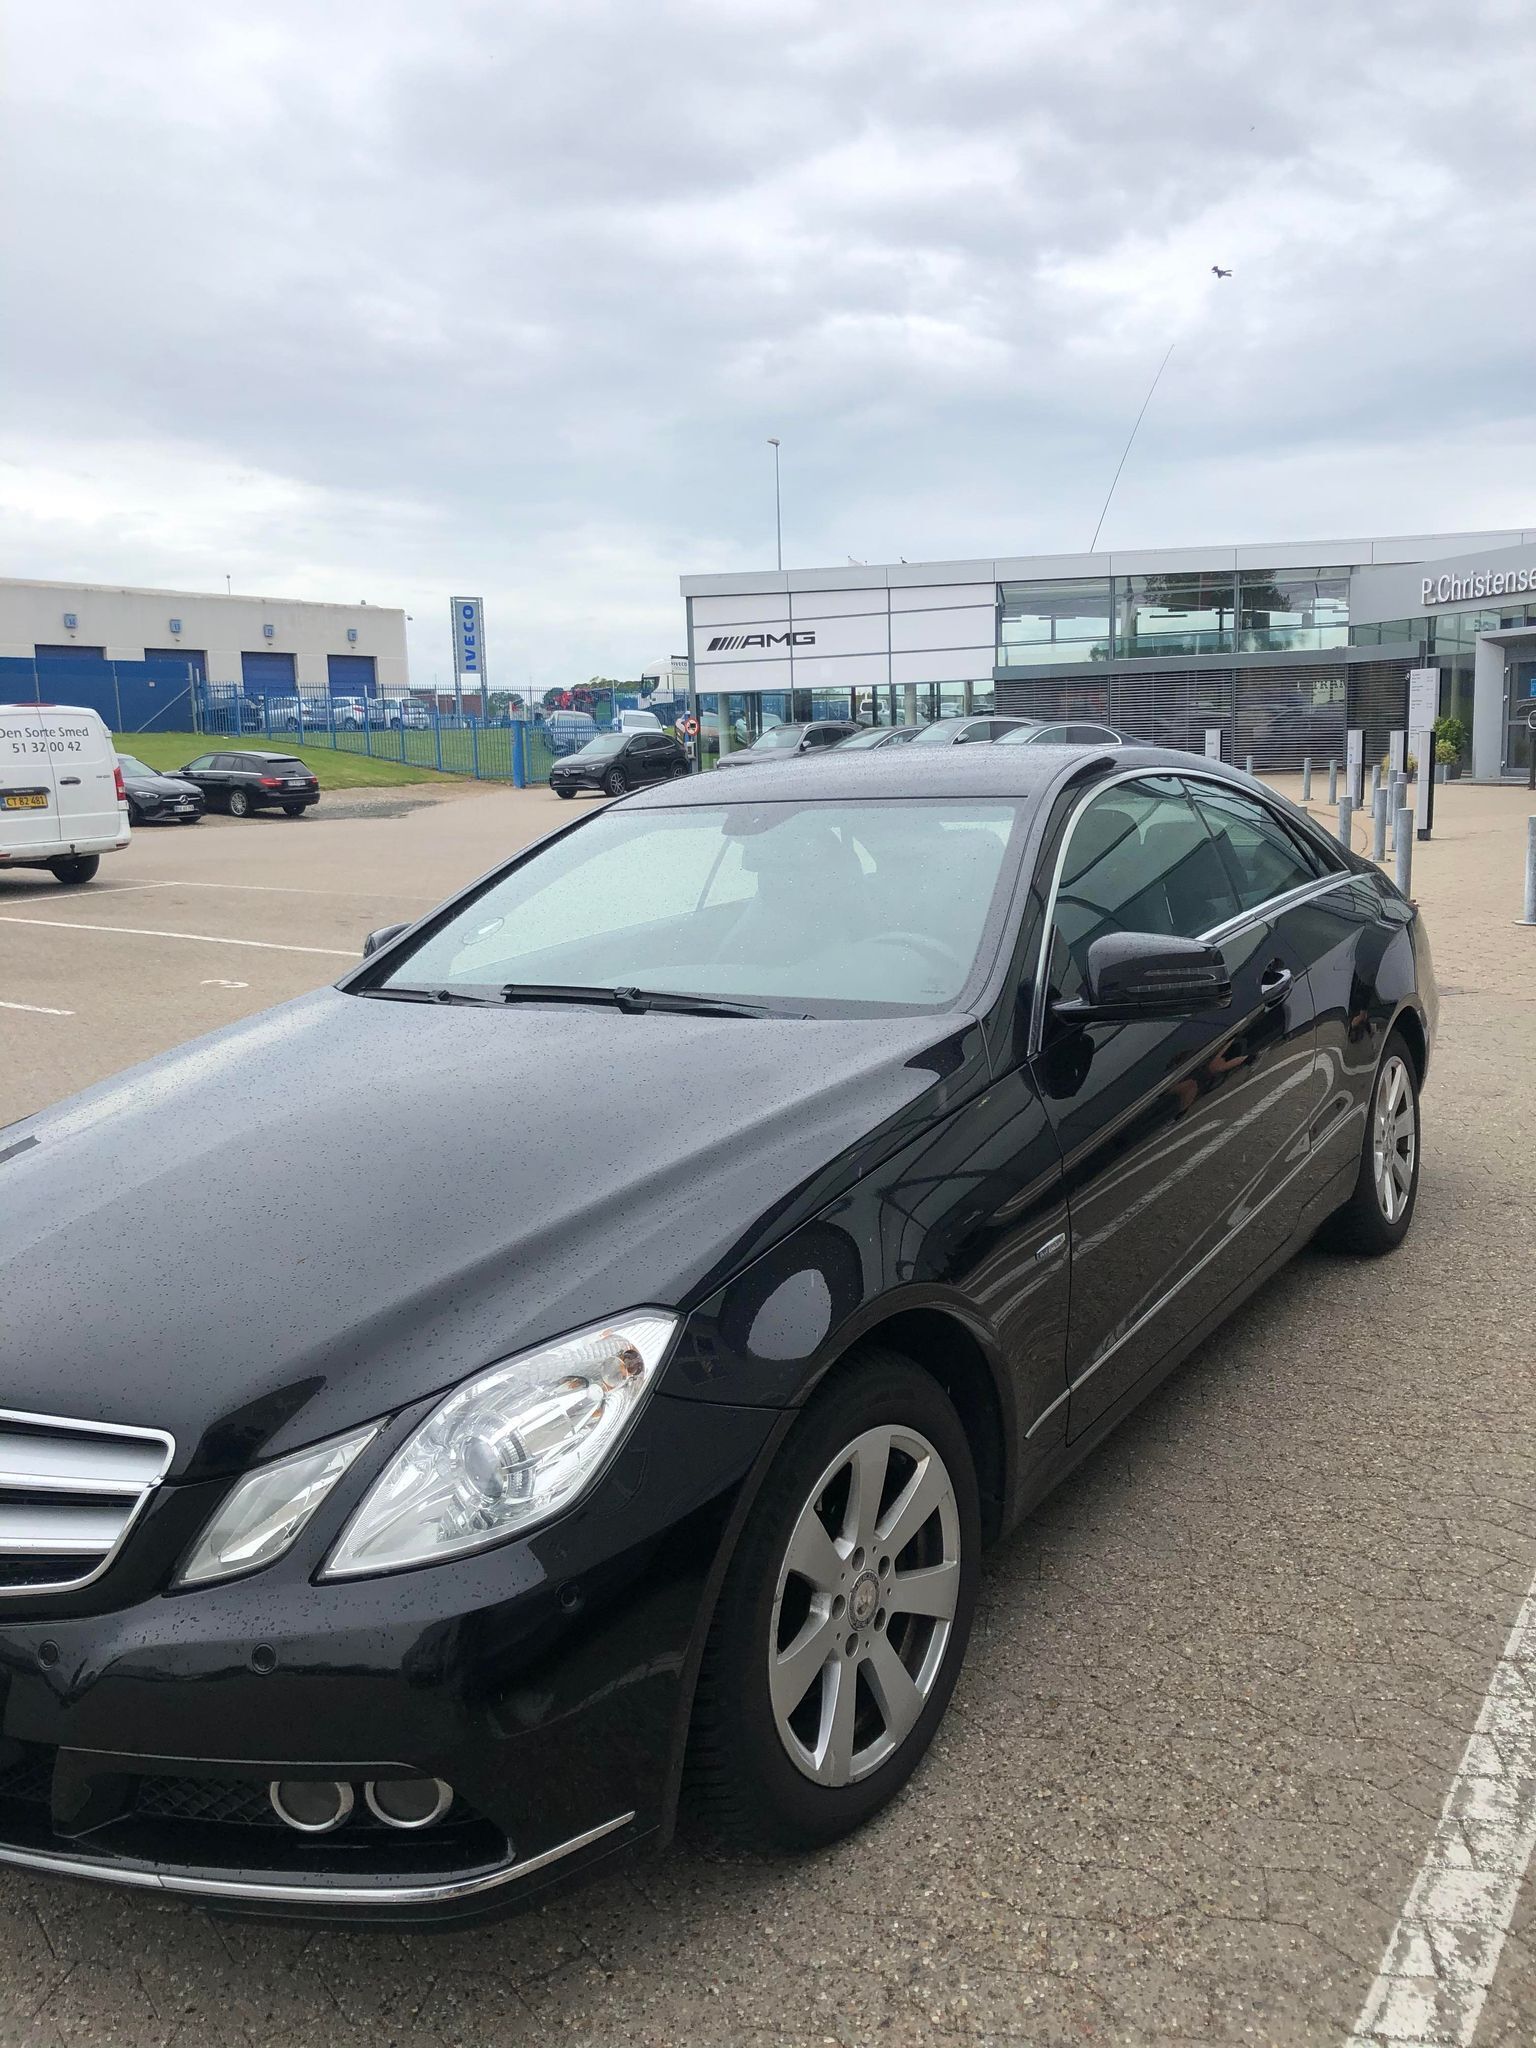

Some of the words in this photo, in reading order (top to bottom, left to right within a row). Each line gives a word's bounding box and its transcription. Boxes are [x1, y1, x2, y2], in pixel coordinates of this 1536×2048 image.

[463, 605, 477, 670] IVECO
[740, 631, 816, 650] AMG
[25, 727, 57, 738] Sorte
[59, 726, 89, 737] Smed
[12, 743, 26, 753] 51
[32, 742, 46, 753] 32
[50, 742, 65, 752] 00
[68, 741, 82, 751] 42
